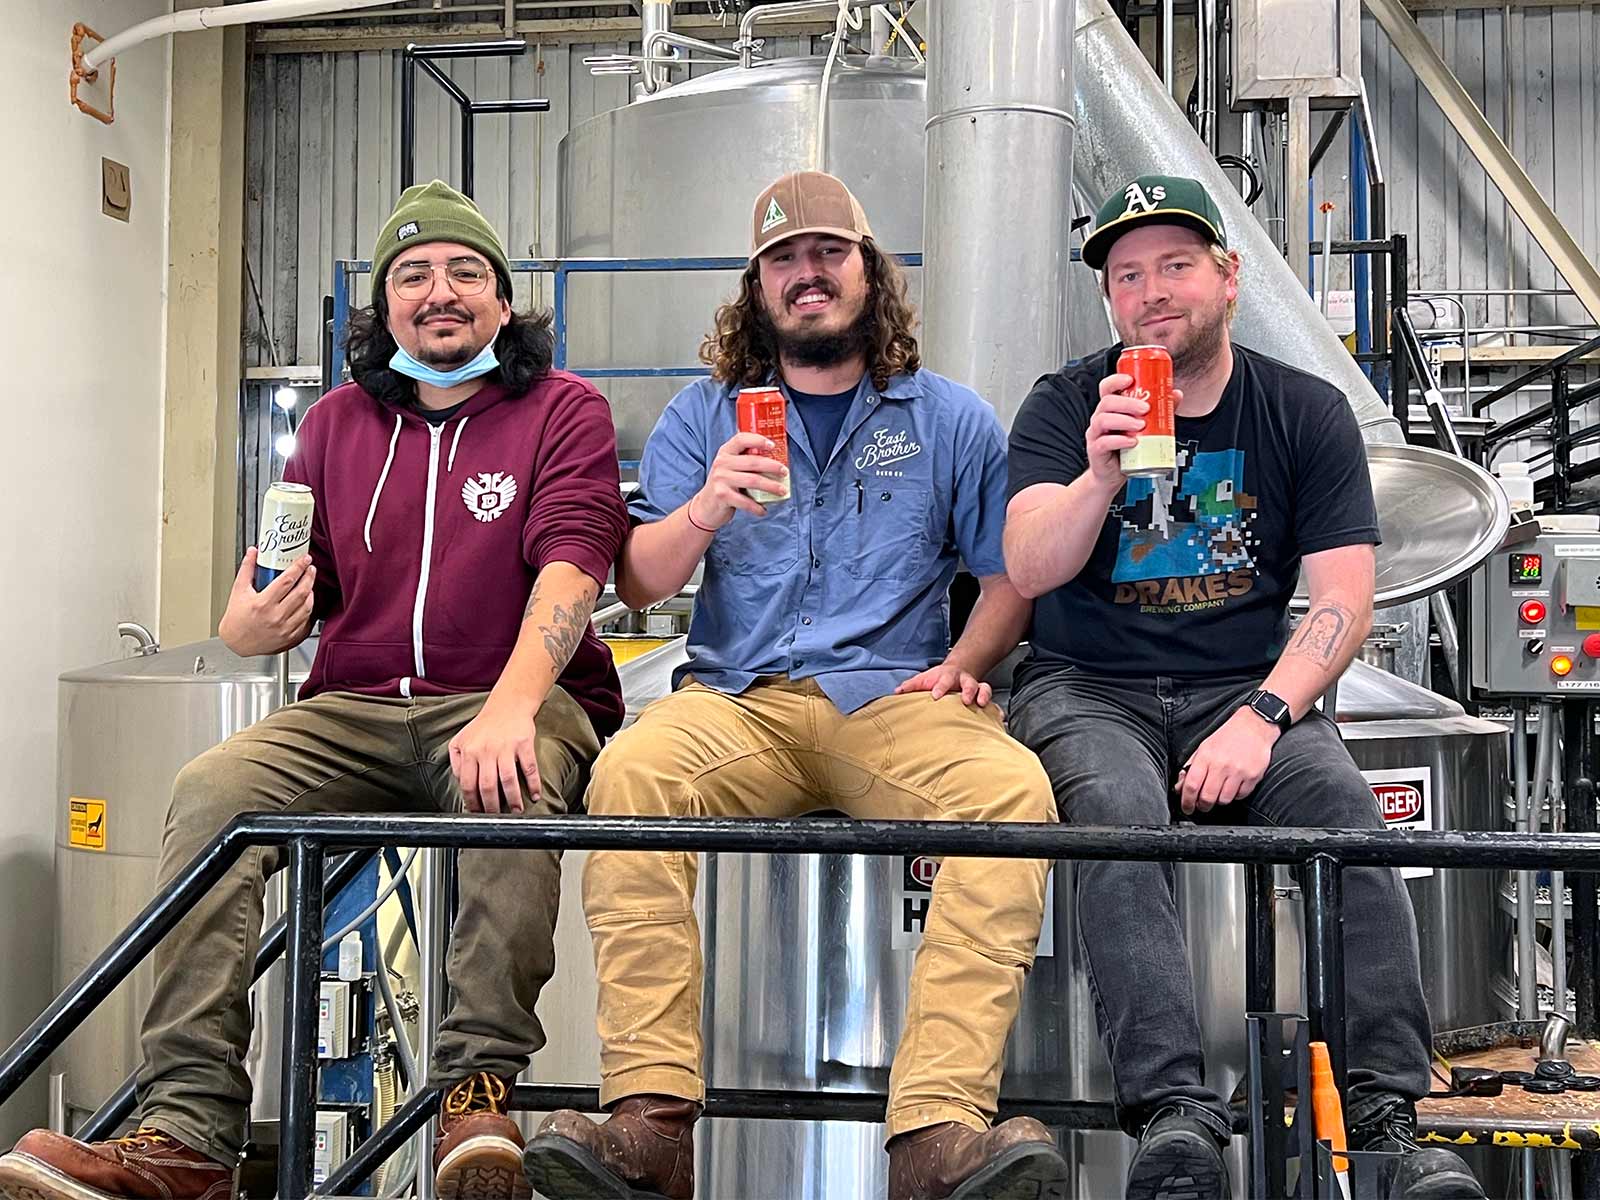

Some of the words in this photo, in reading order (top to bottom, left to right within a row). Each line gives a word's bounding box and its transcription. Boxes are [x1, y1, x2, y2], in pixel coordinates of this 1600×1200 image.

[1119, 182, 1167, 219] A's
[873, 428, 907, 448] East
[855, 443, 921, 470] Brother
[275, 513, 309, 533] East
[1114, 568, 1253, 605] DRAKES
[1140, 605, 1181, 613] BREWING
[1183, 599, 1225, 613] COMPANY
